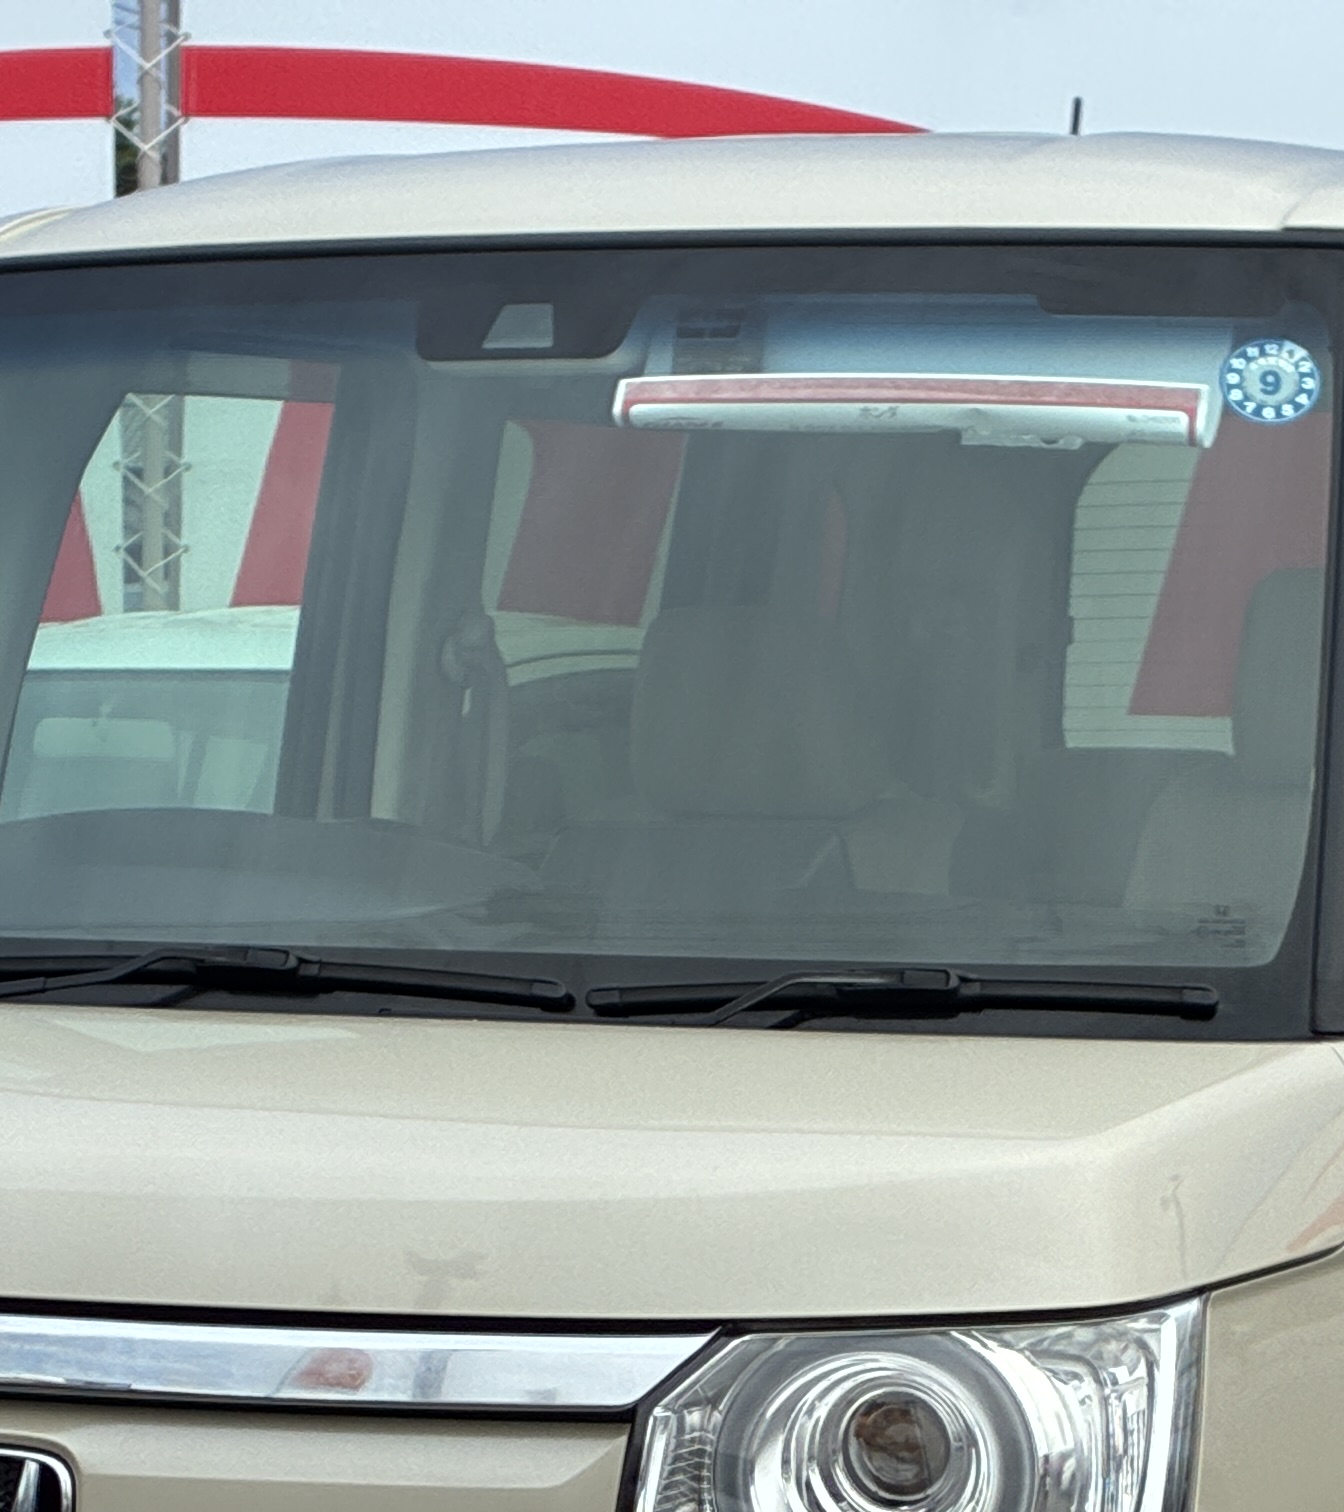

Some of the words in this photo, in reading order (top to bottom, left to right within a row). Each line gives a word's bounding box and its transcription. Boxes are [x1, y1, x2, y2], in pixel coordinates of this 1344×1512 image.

[1298, 361, 1311, 373] 2
[1226, 373, 1240, 384] 9
[1259, 369, 1282, 396] 9
[1301, 377, 1315, 390] 3
[1229, 389, 1243, 400] 8
[1295, 393, 1309, 405] 4
[1243, 402, 1256, 413] 7
[1262, 407, 1275, 419] 6
[1281, 404, 1294, 416] 5
